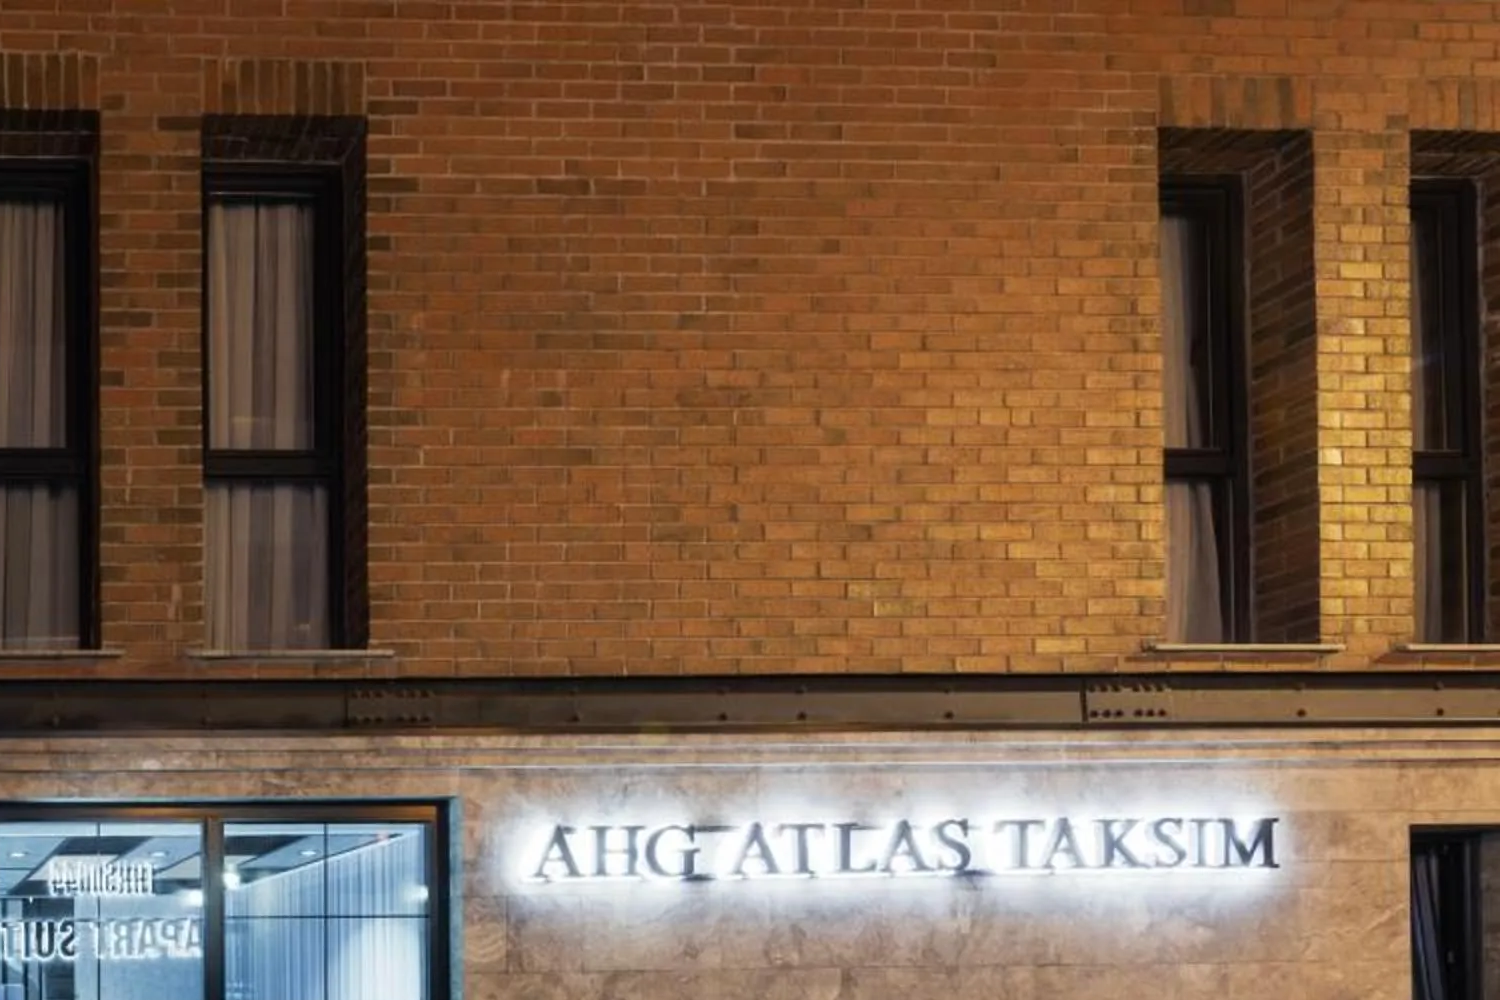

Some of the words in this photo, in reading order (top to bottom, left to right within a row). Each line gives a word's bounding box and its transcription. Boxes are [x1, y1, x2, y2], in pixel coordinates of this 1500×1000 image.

[532, 824, 701, 878] AHG
[731, 819, 972, 876] ATLAS
[994, 817, 1280, 870] TAKSIM
